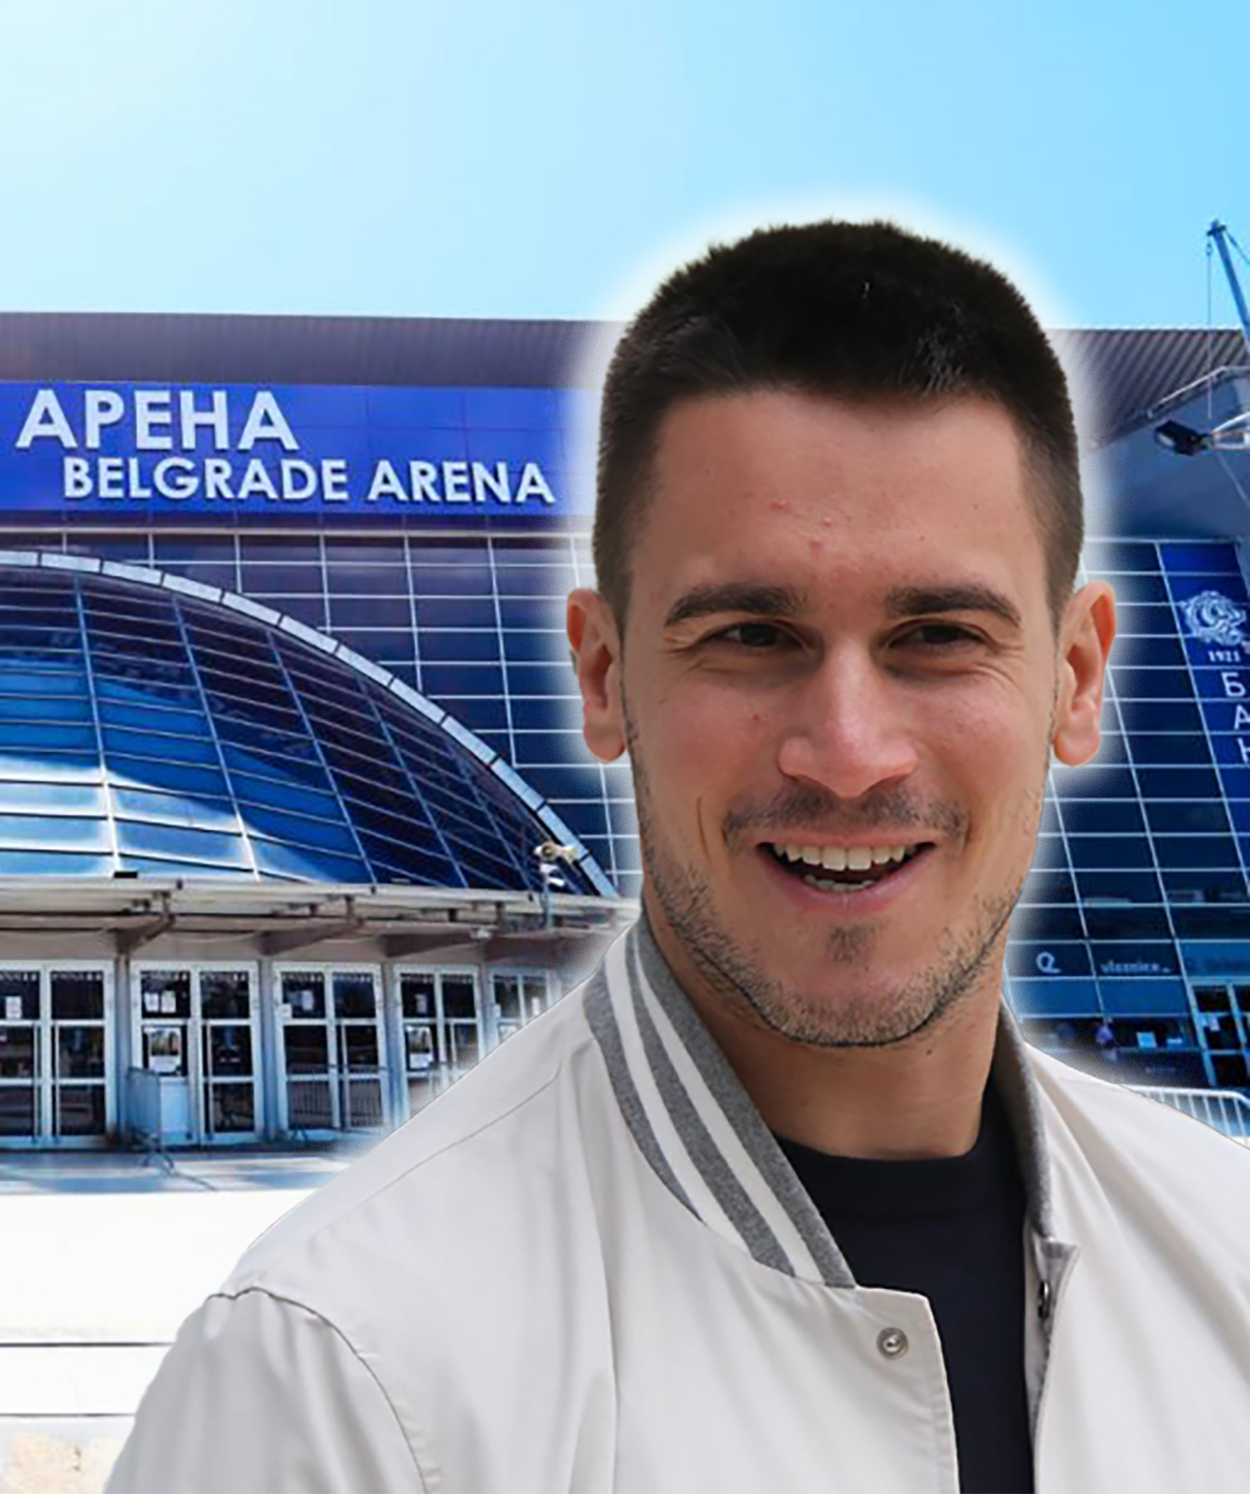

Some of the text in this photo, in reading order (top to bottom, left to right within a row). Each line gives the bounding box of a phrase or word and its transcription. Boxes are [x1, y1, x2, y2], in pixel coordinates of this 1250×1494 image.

[15, 389, 299, 450] АРЕНА
[63, 457, 555, 504] BELGRADE ARENA
